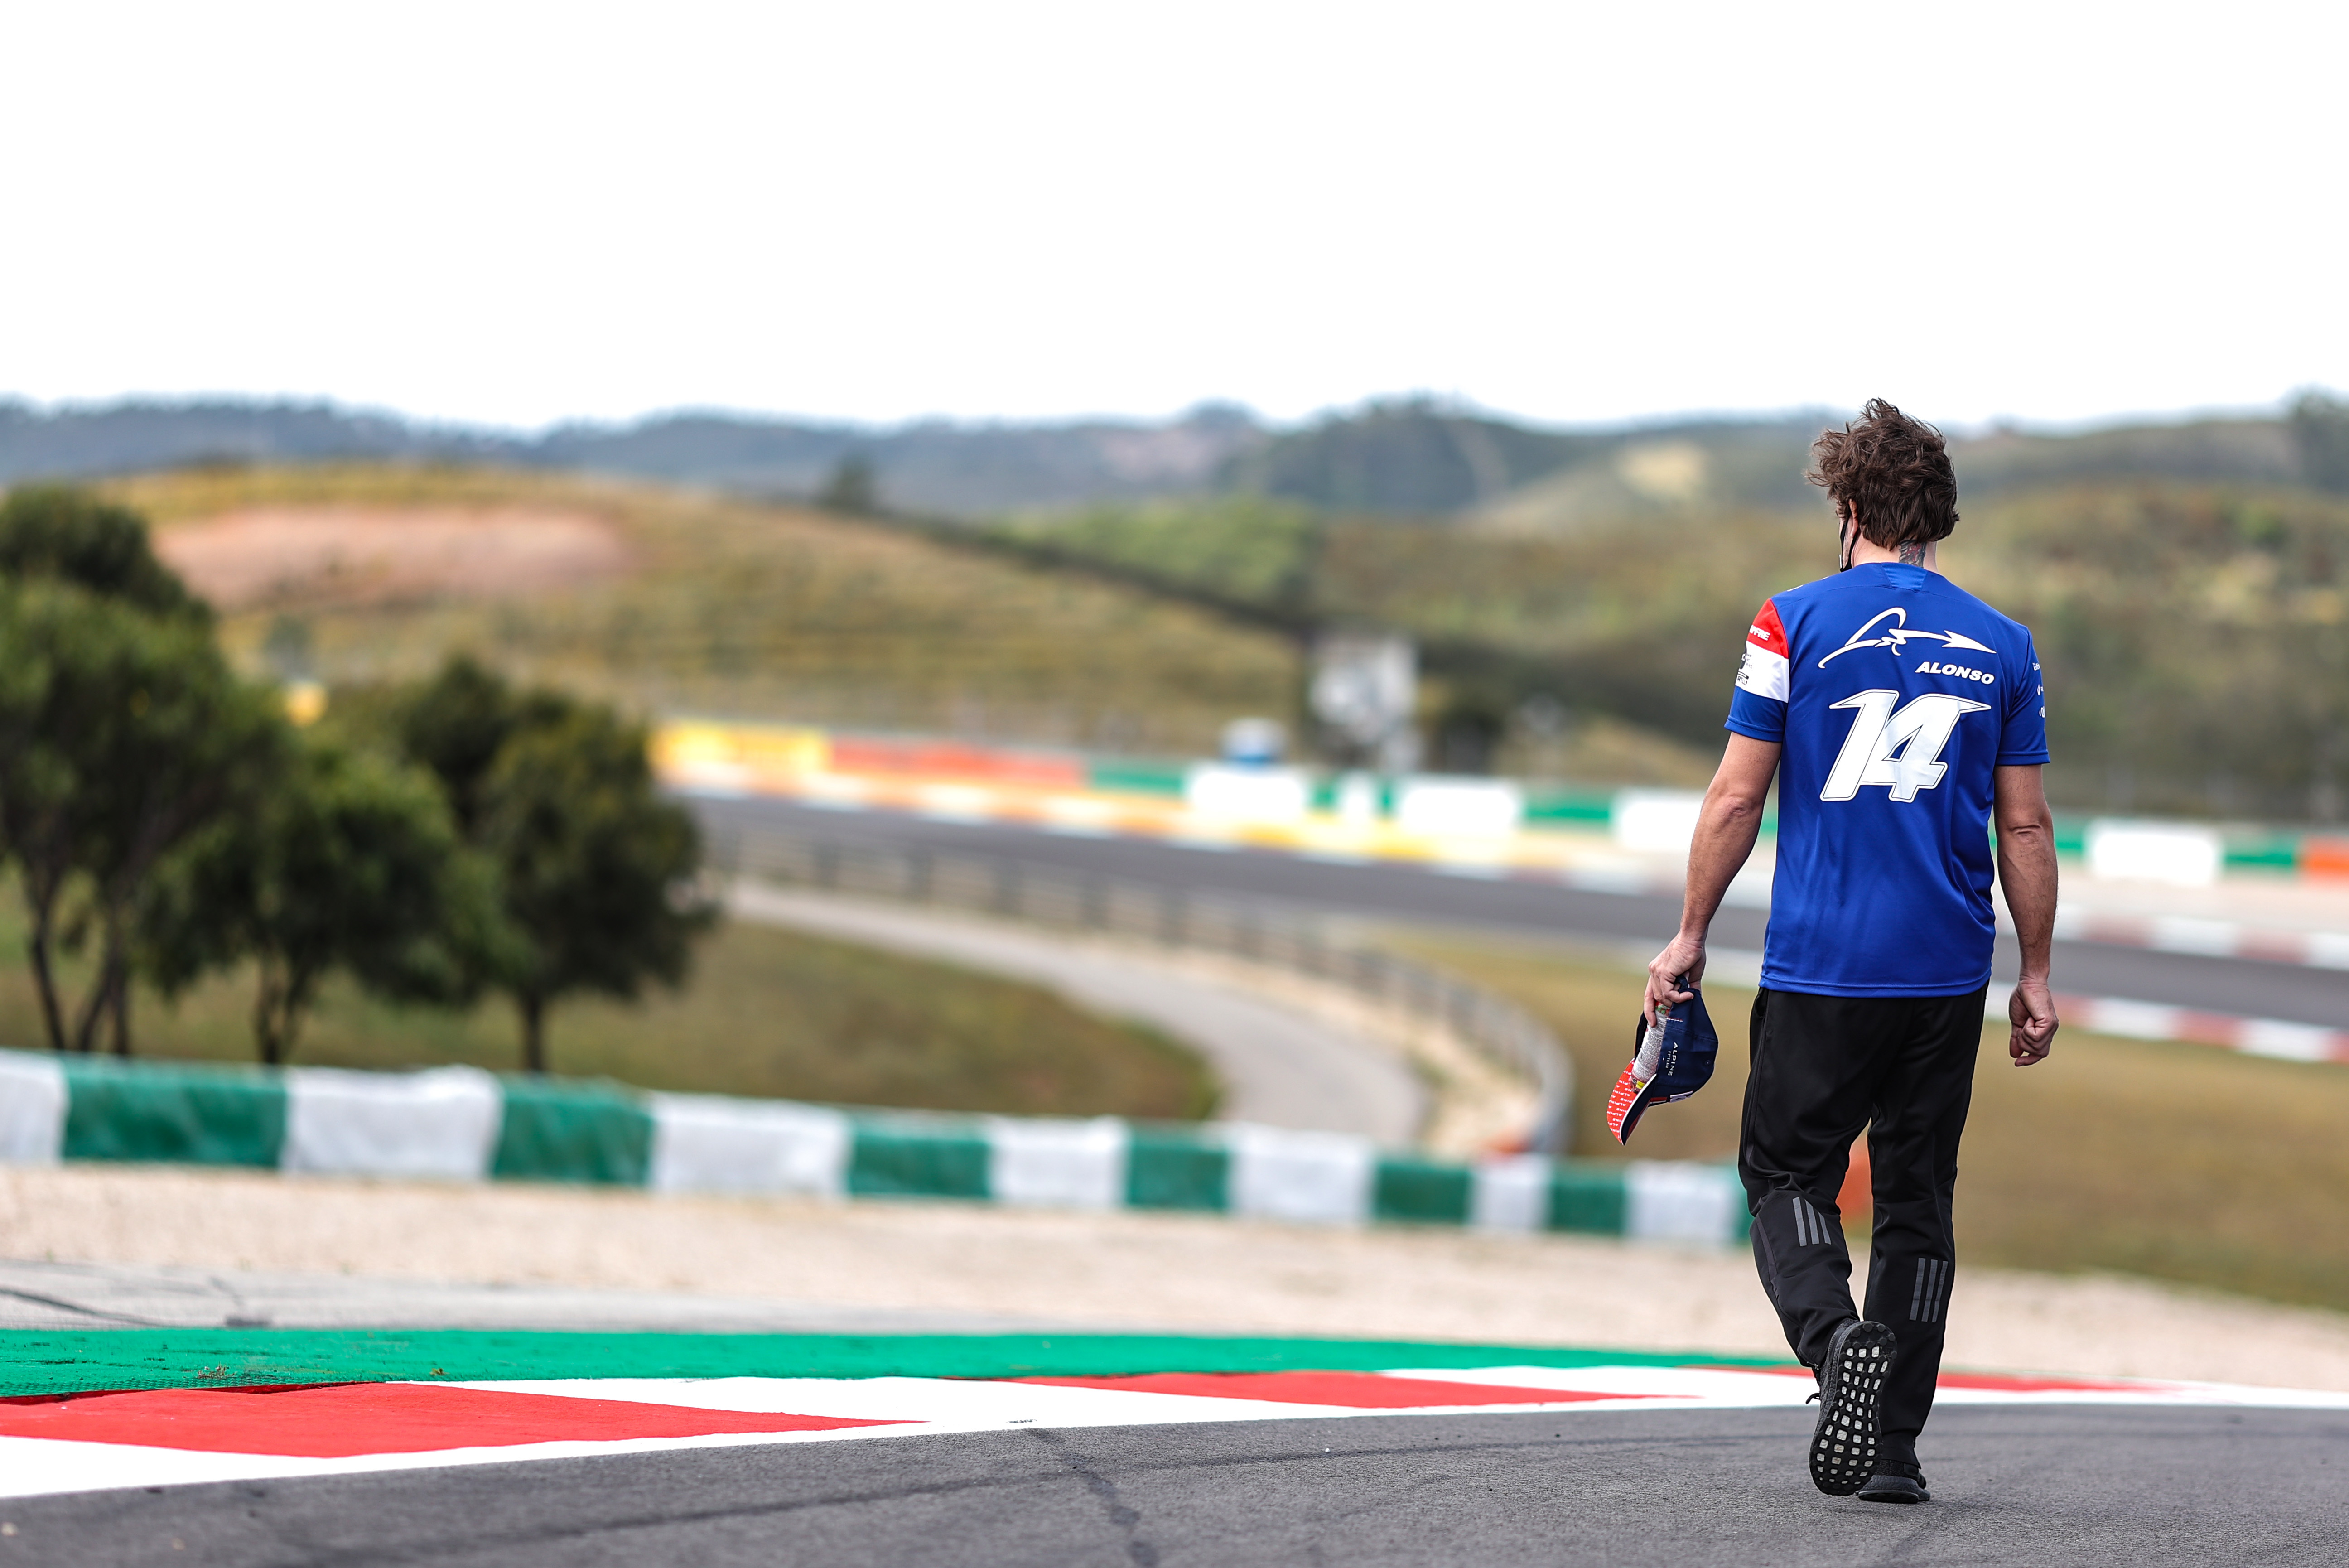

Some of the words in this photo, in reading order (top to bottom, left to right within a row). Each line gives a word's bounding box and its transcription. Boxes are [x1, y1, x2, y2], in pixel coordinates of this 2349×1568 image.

[1915, 661, 1994, 685] ALONSO
[1820, 689, 1992, 803] 14
[1668, 1042, 1678, 1076] ALPINE
